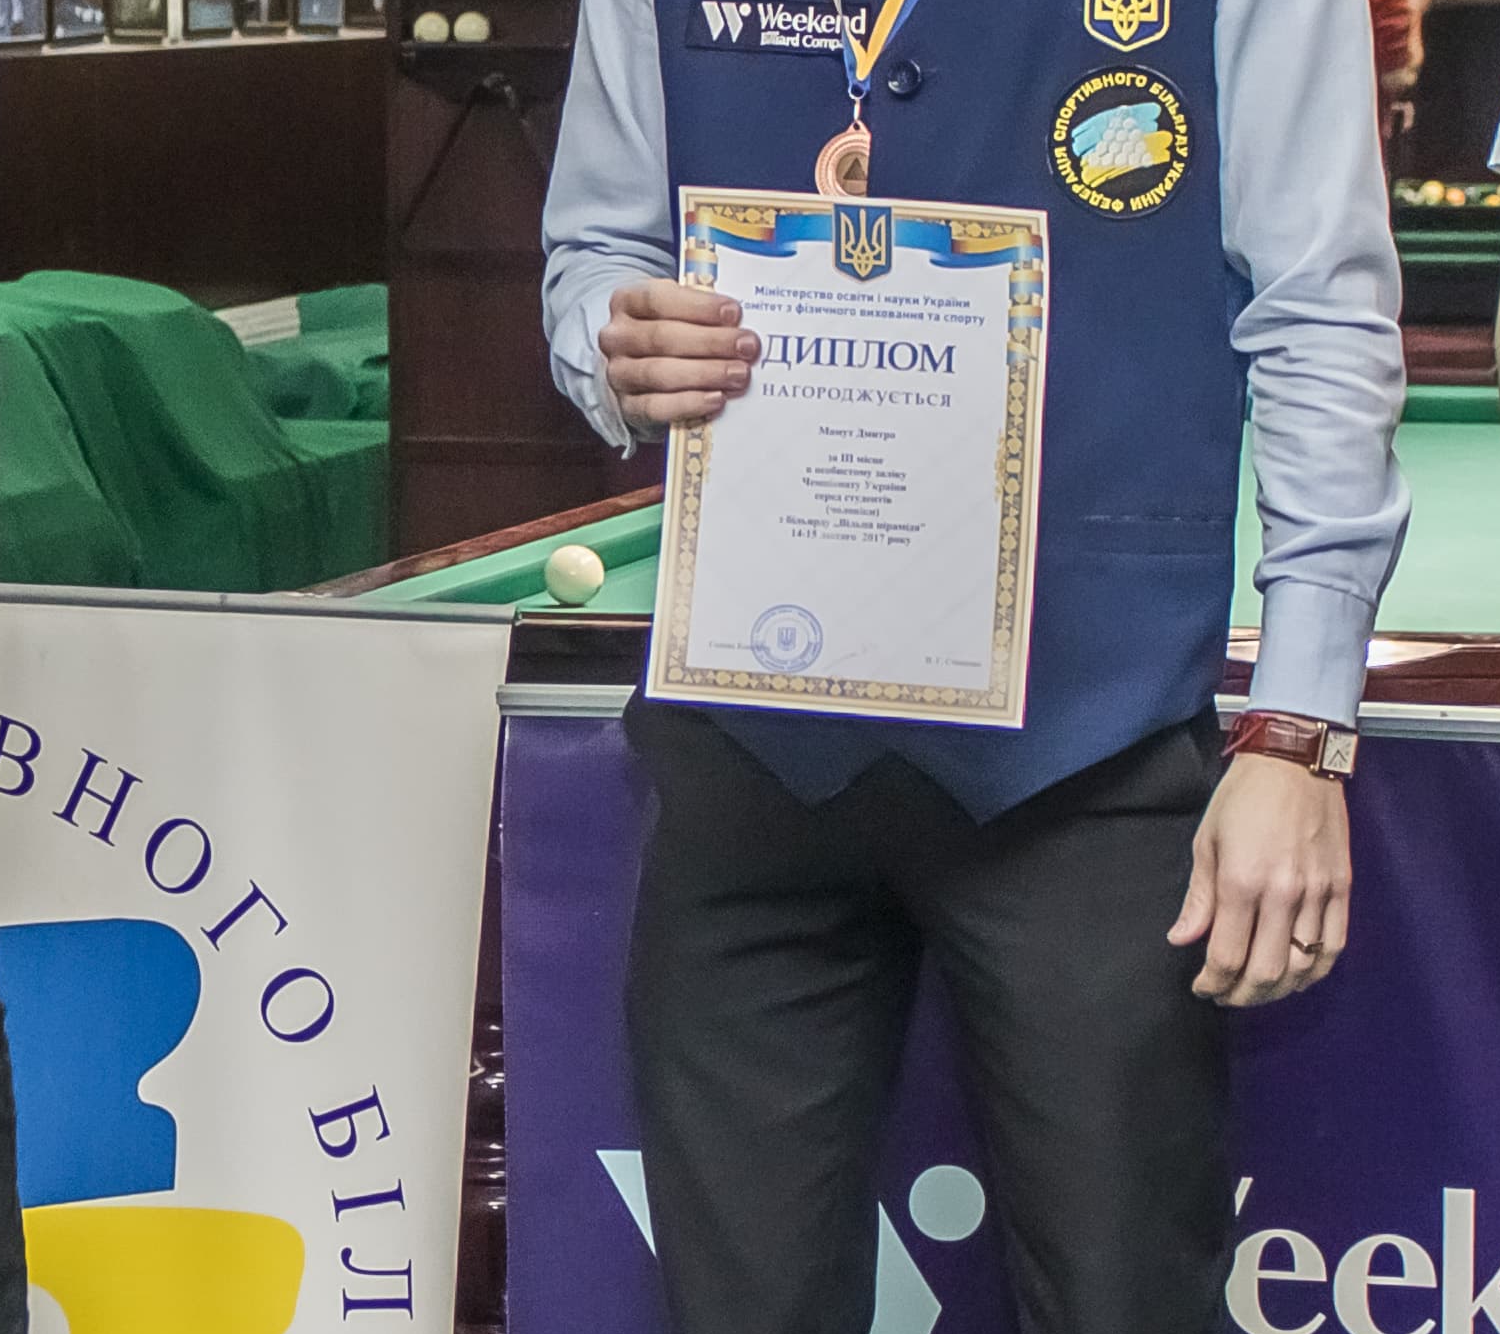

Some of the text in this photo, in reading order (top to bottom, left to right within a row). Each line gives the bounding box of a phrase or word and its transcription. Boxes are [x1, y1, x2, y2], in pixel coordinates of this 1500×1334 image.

[757, 3, 866, 35] Weekend
[1054, 72, 1188, 213] ФЕДЕРАЦІЯ СПОРТИВНОГО БІЛЬЯРДУ УКРАЇНИ
[754, 285, 834, 301] Міністерство
[836, 291, 874, 302] освіти
[884, 295, 920, 307] науки
[923, 295, 971, 308] України
[795, 303, 856, 316] фізичного
[859, 308, 924, 320] виховання
[928, 312, 940, 322] та
[943, 314, 985, 327] спорту
[761, 333, 956, 374] ДИПЛОМ
[762, 383, 952, 407] НАГОРОДЖУЄТЬСЯ
